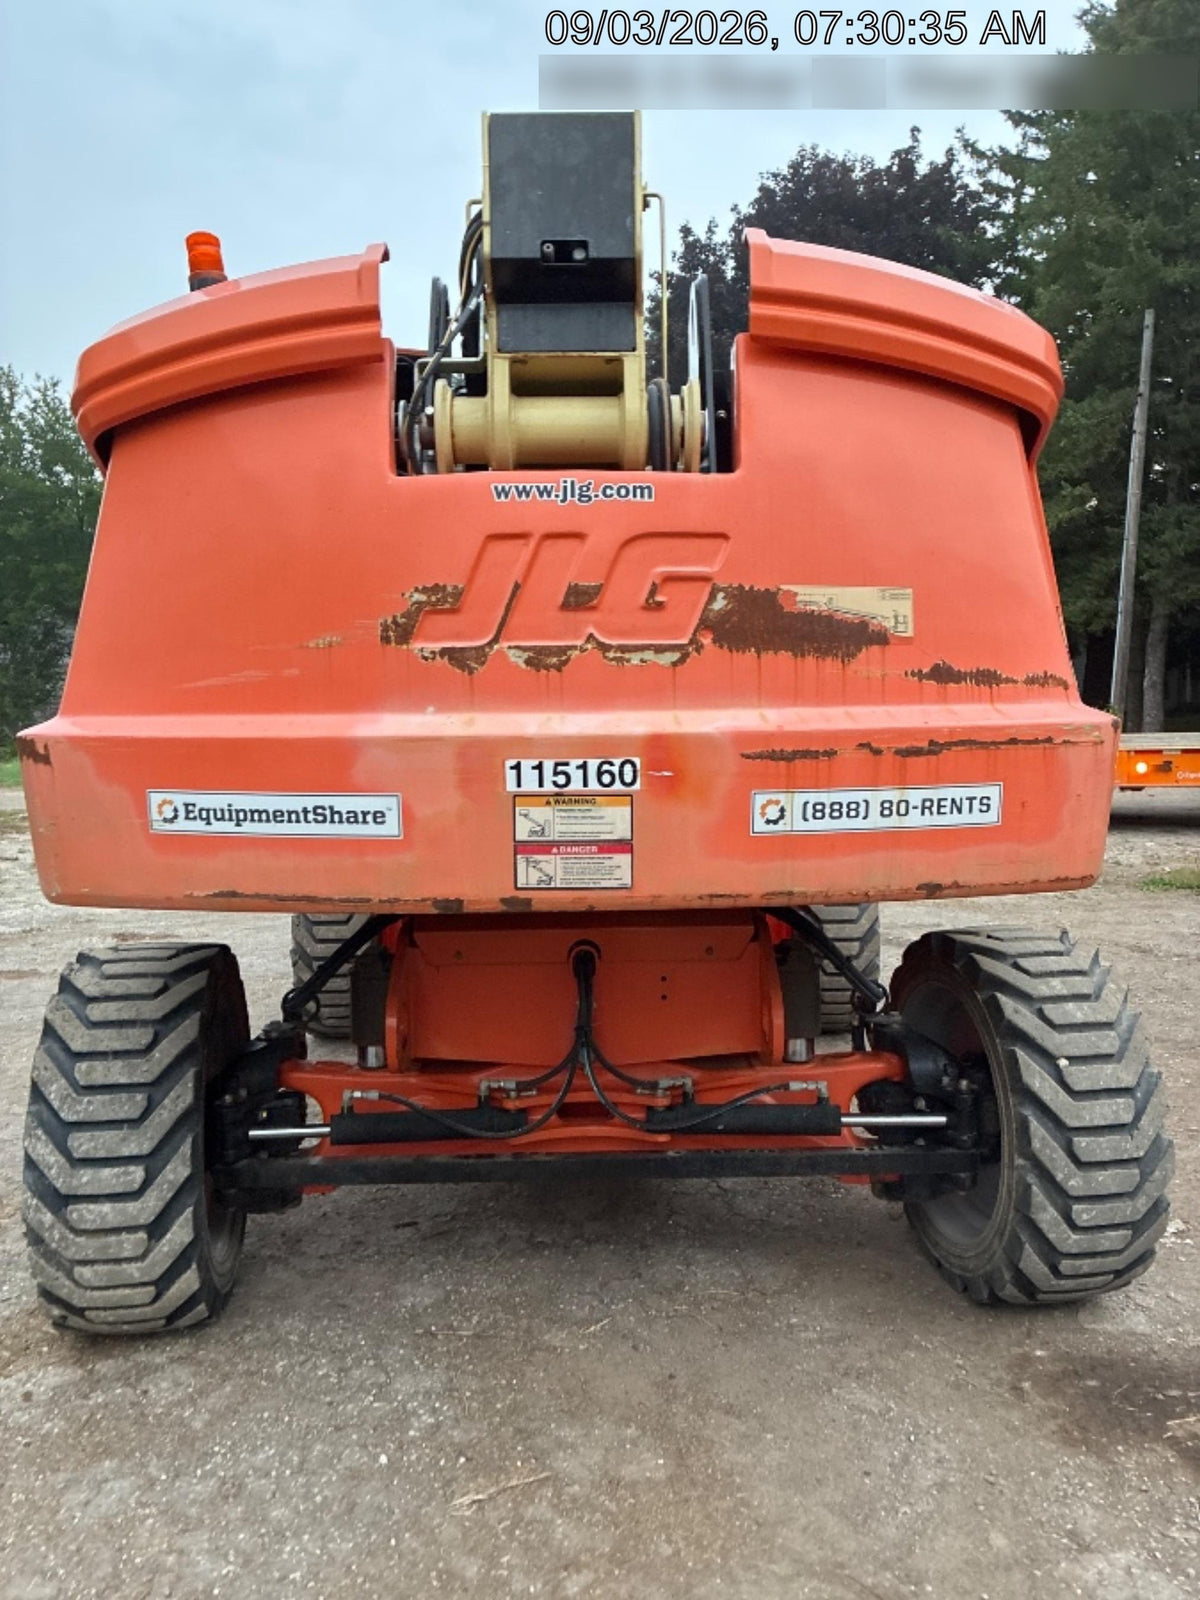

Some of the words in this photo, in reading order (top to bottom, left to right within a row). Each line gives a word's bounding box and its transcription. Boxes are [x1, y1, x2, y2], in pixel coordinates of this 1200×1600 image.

[493, 480, 654, 504] www.jlg.com
[410, 531, 731, 647] JLG
[509, 759, 638, 788] 115160
[553, 797, 597, 806] WARNING
[801, 800, 870, 822] (888)
[879, 796, 992, 818] 80-RENTS
[183, 803, 386, 827] EquipmentShare
[559, 846, 598, 854] DANGER
